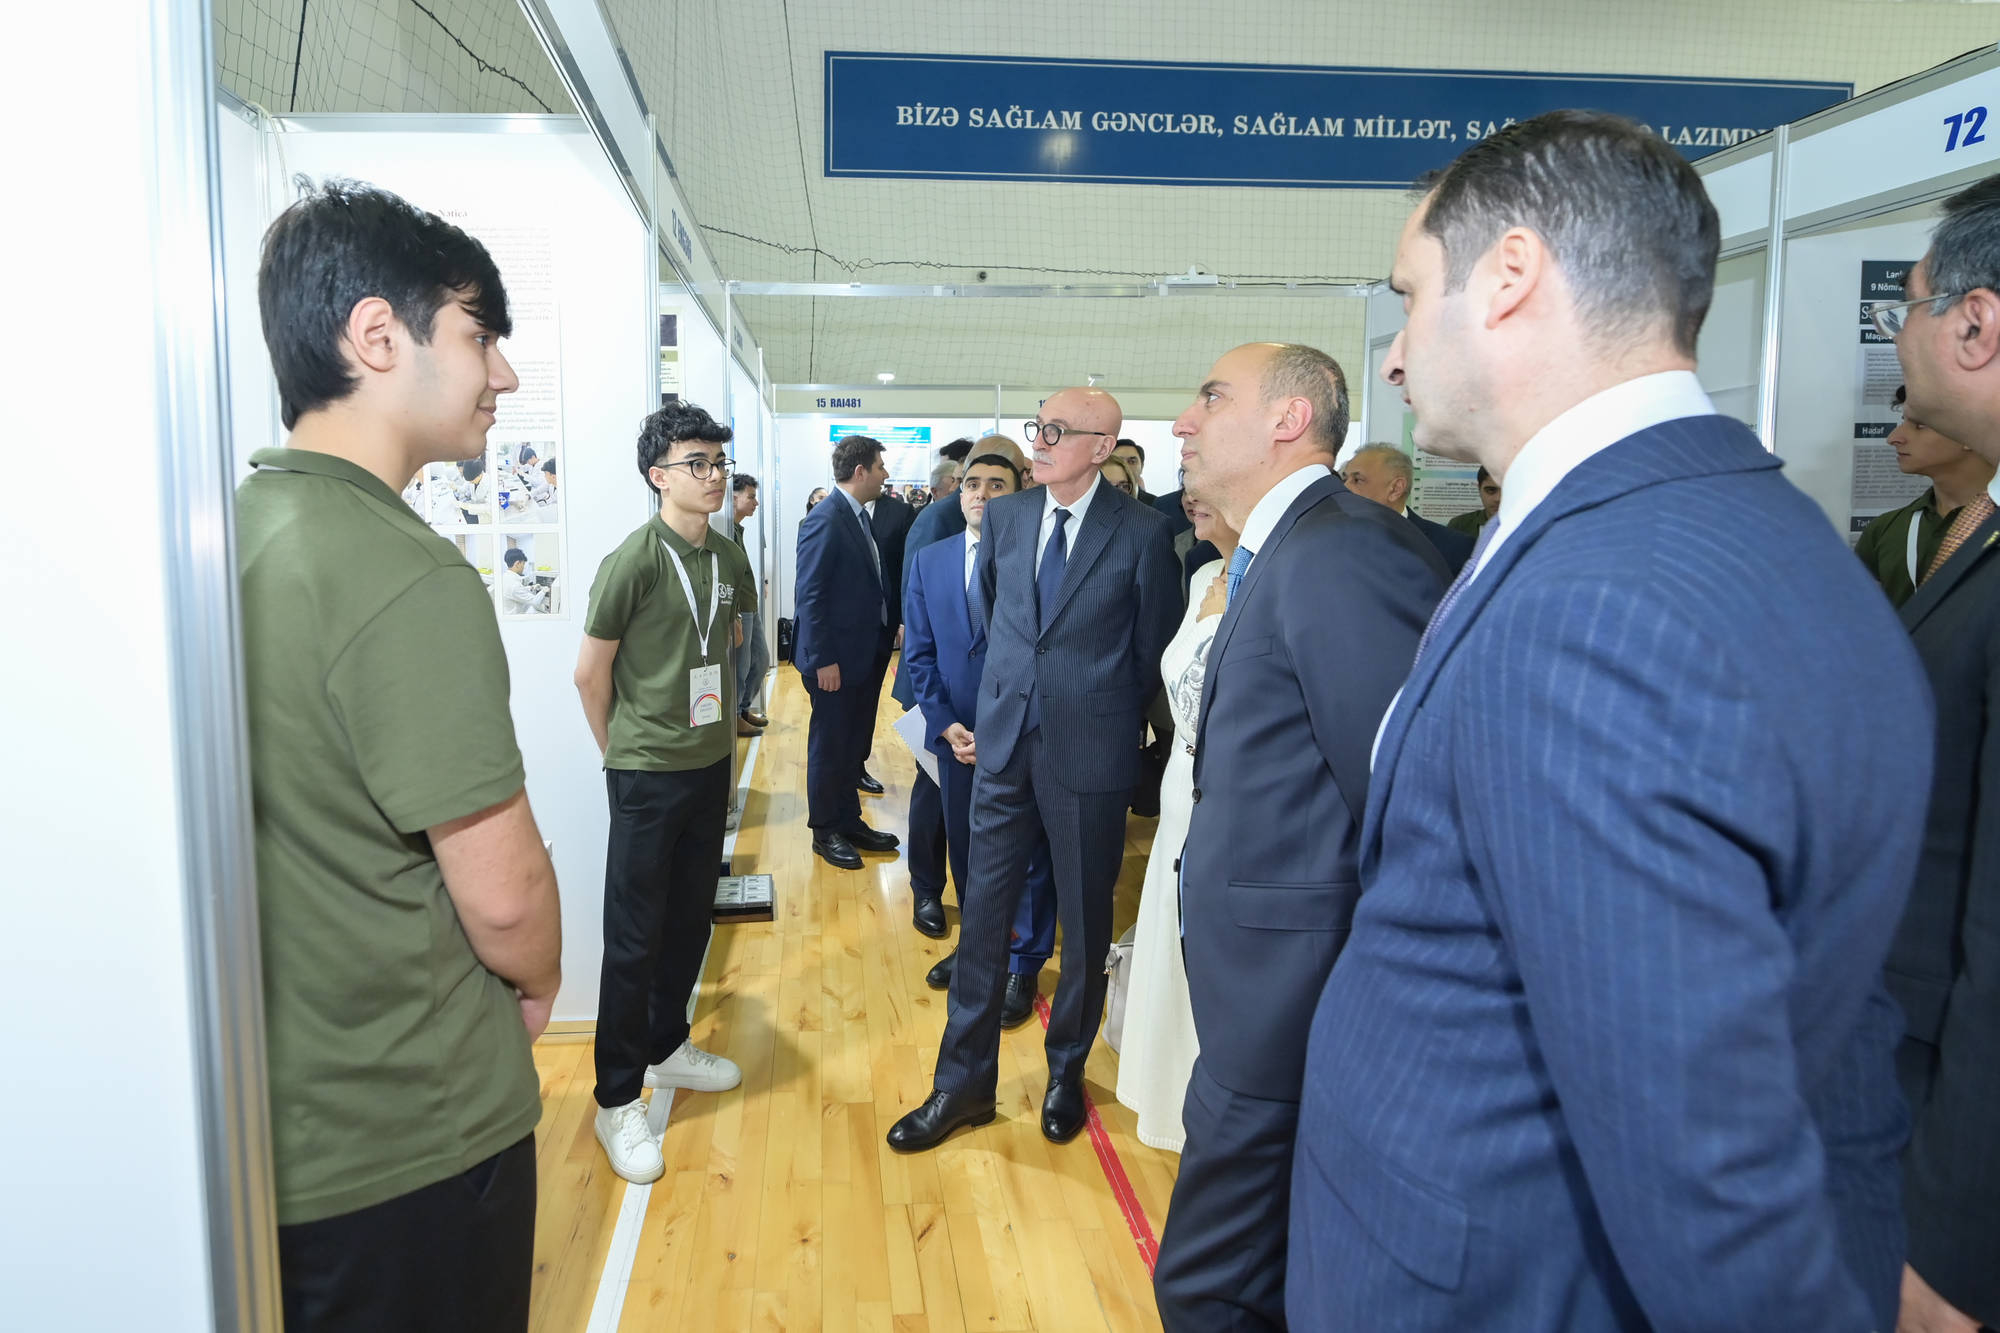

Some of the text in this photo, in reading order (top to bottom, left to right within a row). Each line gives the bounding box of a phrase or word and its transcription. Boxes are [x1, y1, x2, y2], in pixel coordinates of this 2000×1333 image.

[896, 102, 959, 127] BİZƏ
[968, 105, 1083, 130] SAĞLAM
[1091, 111, 1224, 138] GƏNCLƏR,
[1233, 112, 1345, 138] SAĞLAM
[1353, 114, 1457, 143] MİLLƏT,
[1943, 106, 1988, 153] 72
[1870, 283, 1877, 291] 9
[816, 398, 862, 408] 15 RAI481
